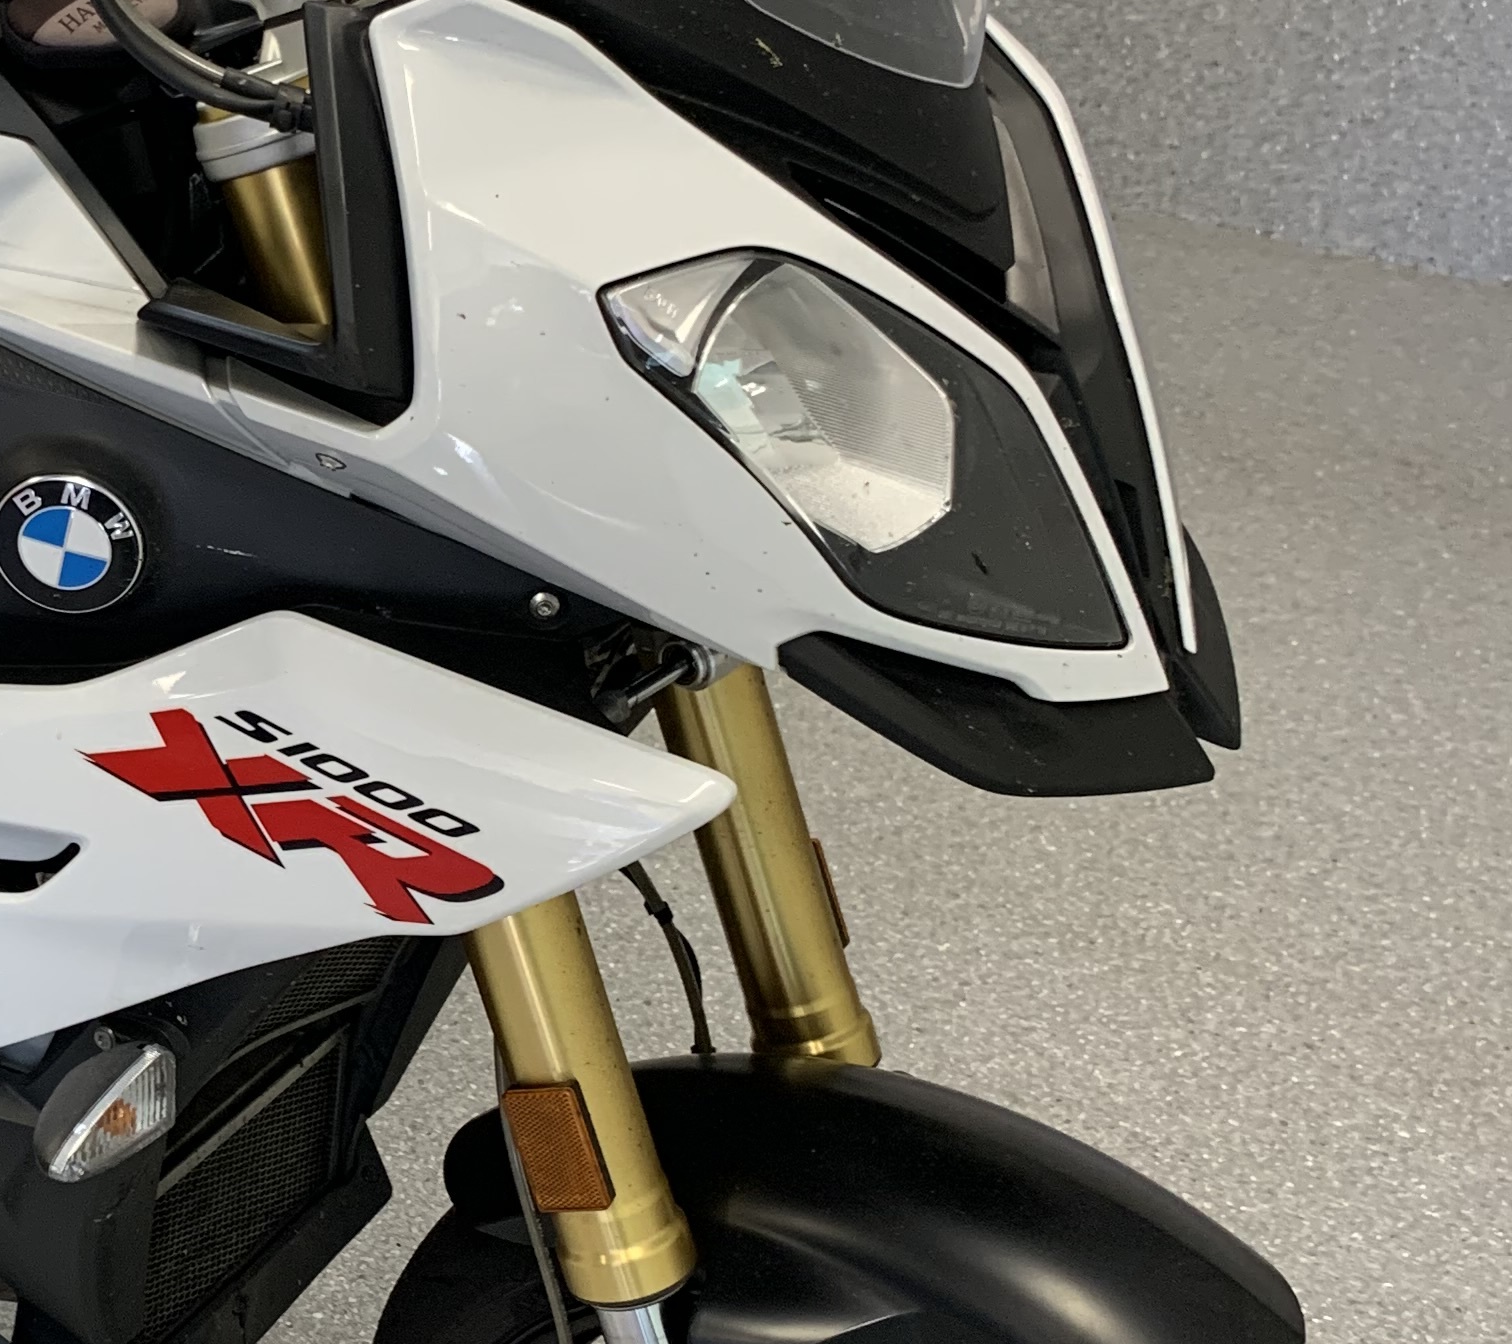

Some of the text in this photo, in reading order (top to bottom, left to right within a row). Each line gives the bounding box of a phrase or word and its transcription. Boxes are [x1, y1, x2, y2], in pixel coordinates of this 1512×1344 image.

[13, 482, 134, 542] BMW
[75, 707, 505, 925] XR
[215, 709, 480, 838] S1000
